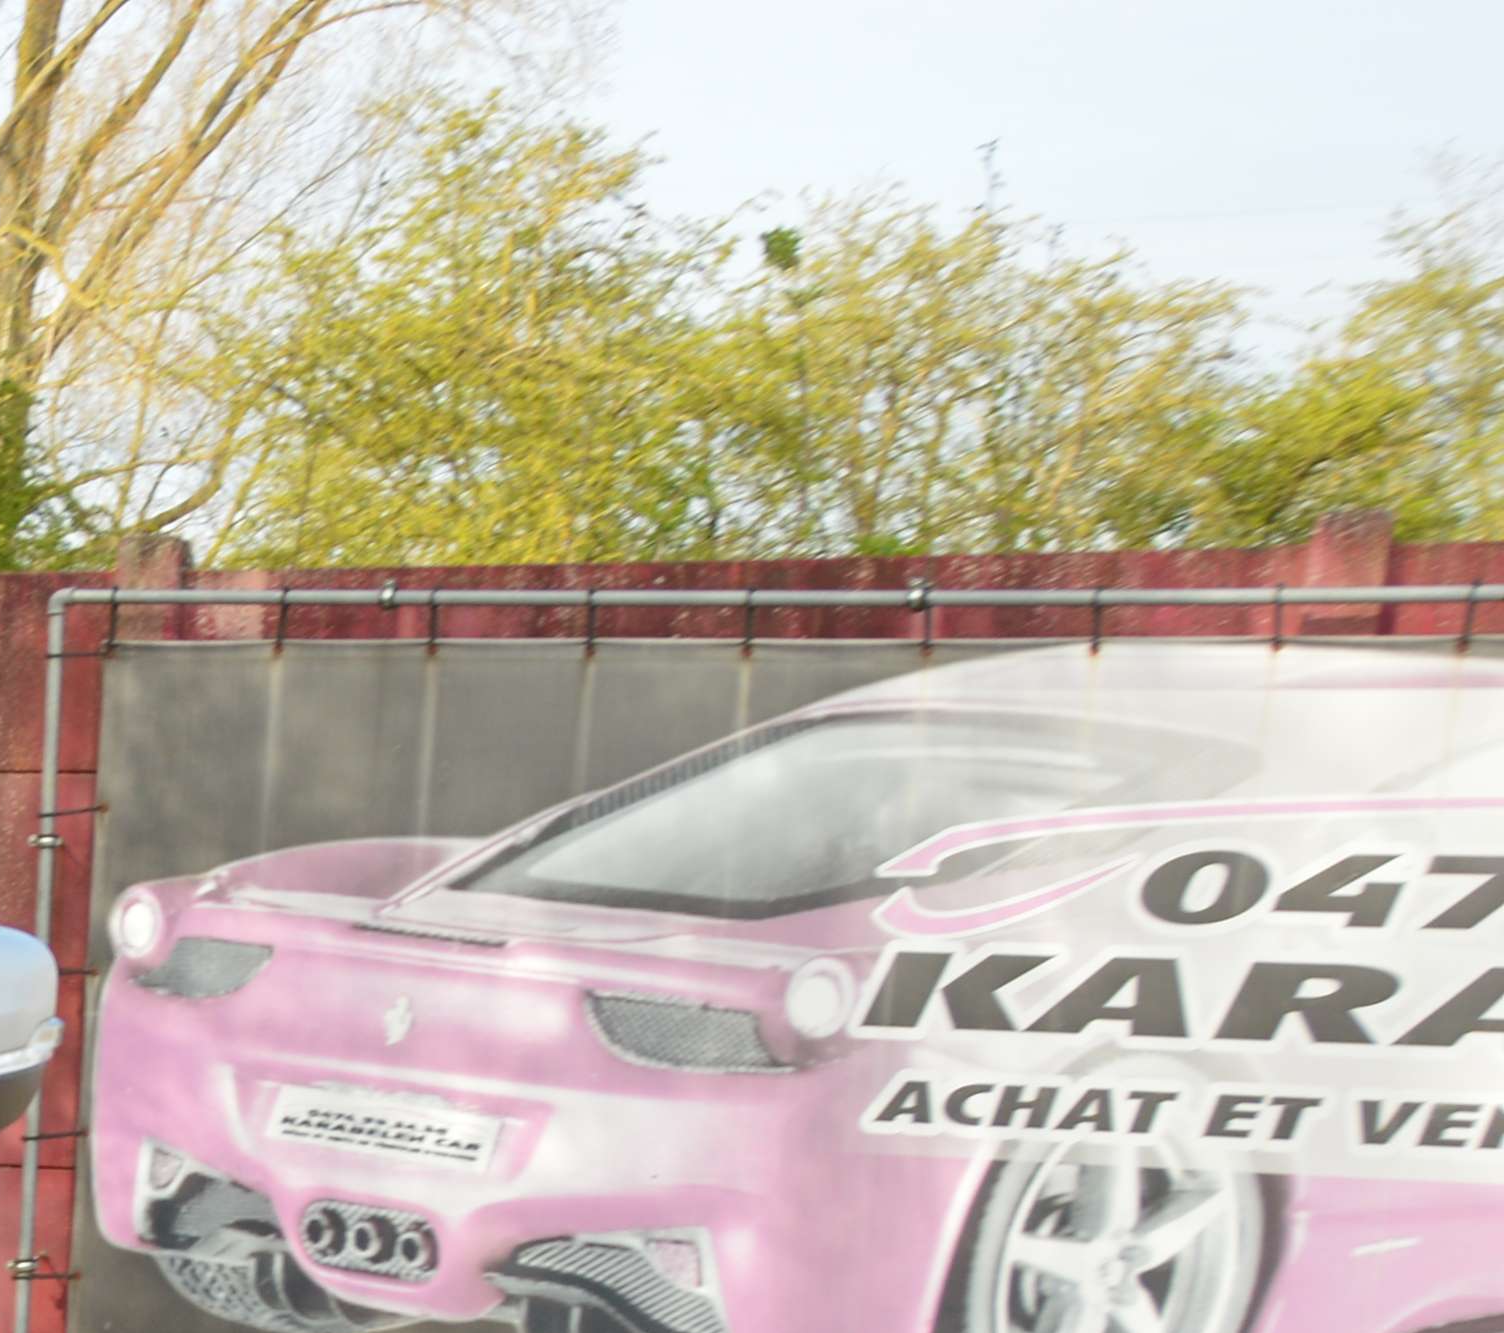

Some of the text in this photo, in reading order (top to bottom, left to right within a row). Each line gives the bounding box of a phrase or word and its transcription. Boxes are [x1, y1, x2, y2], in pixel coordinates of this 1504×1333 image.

[861, 950, 1504, 1047] KARA
[874, 1079, 1180, 1134] ACHAT
[1202, 1094, 1325, 1141] ET
